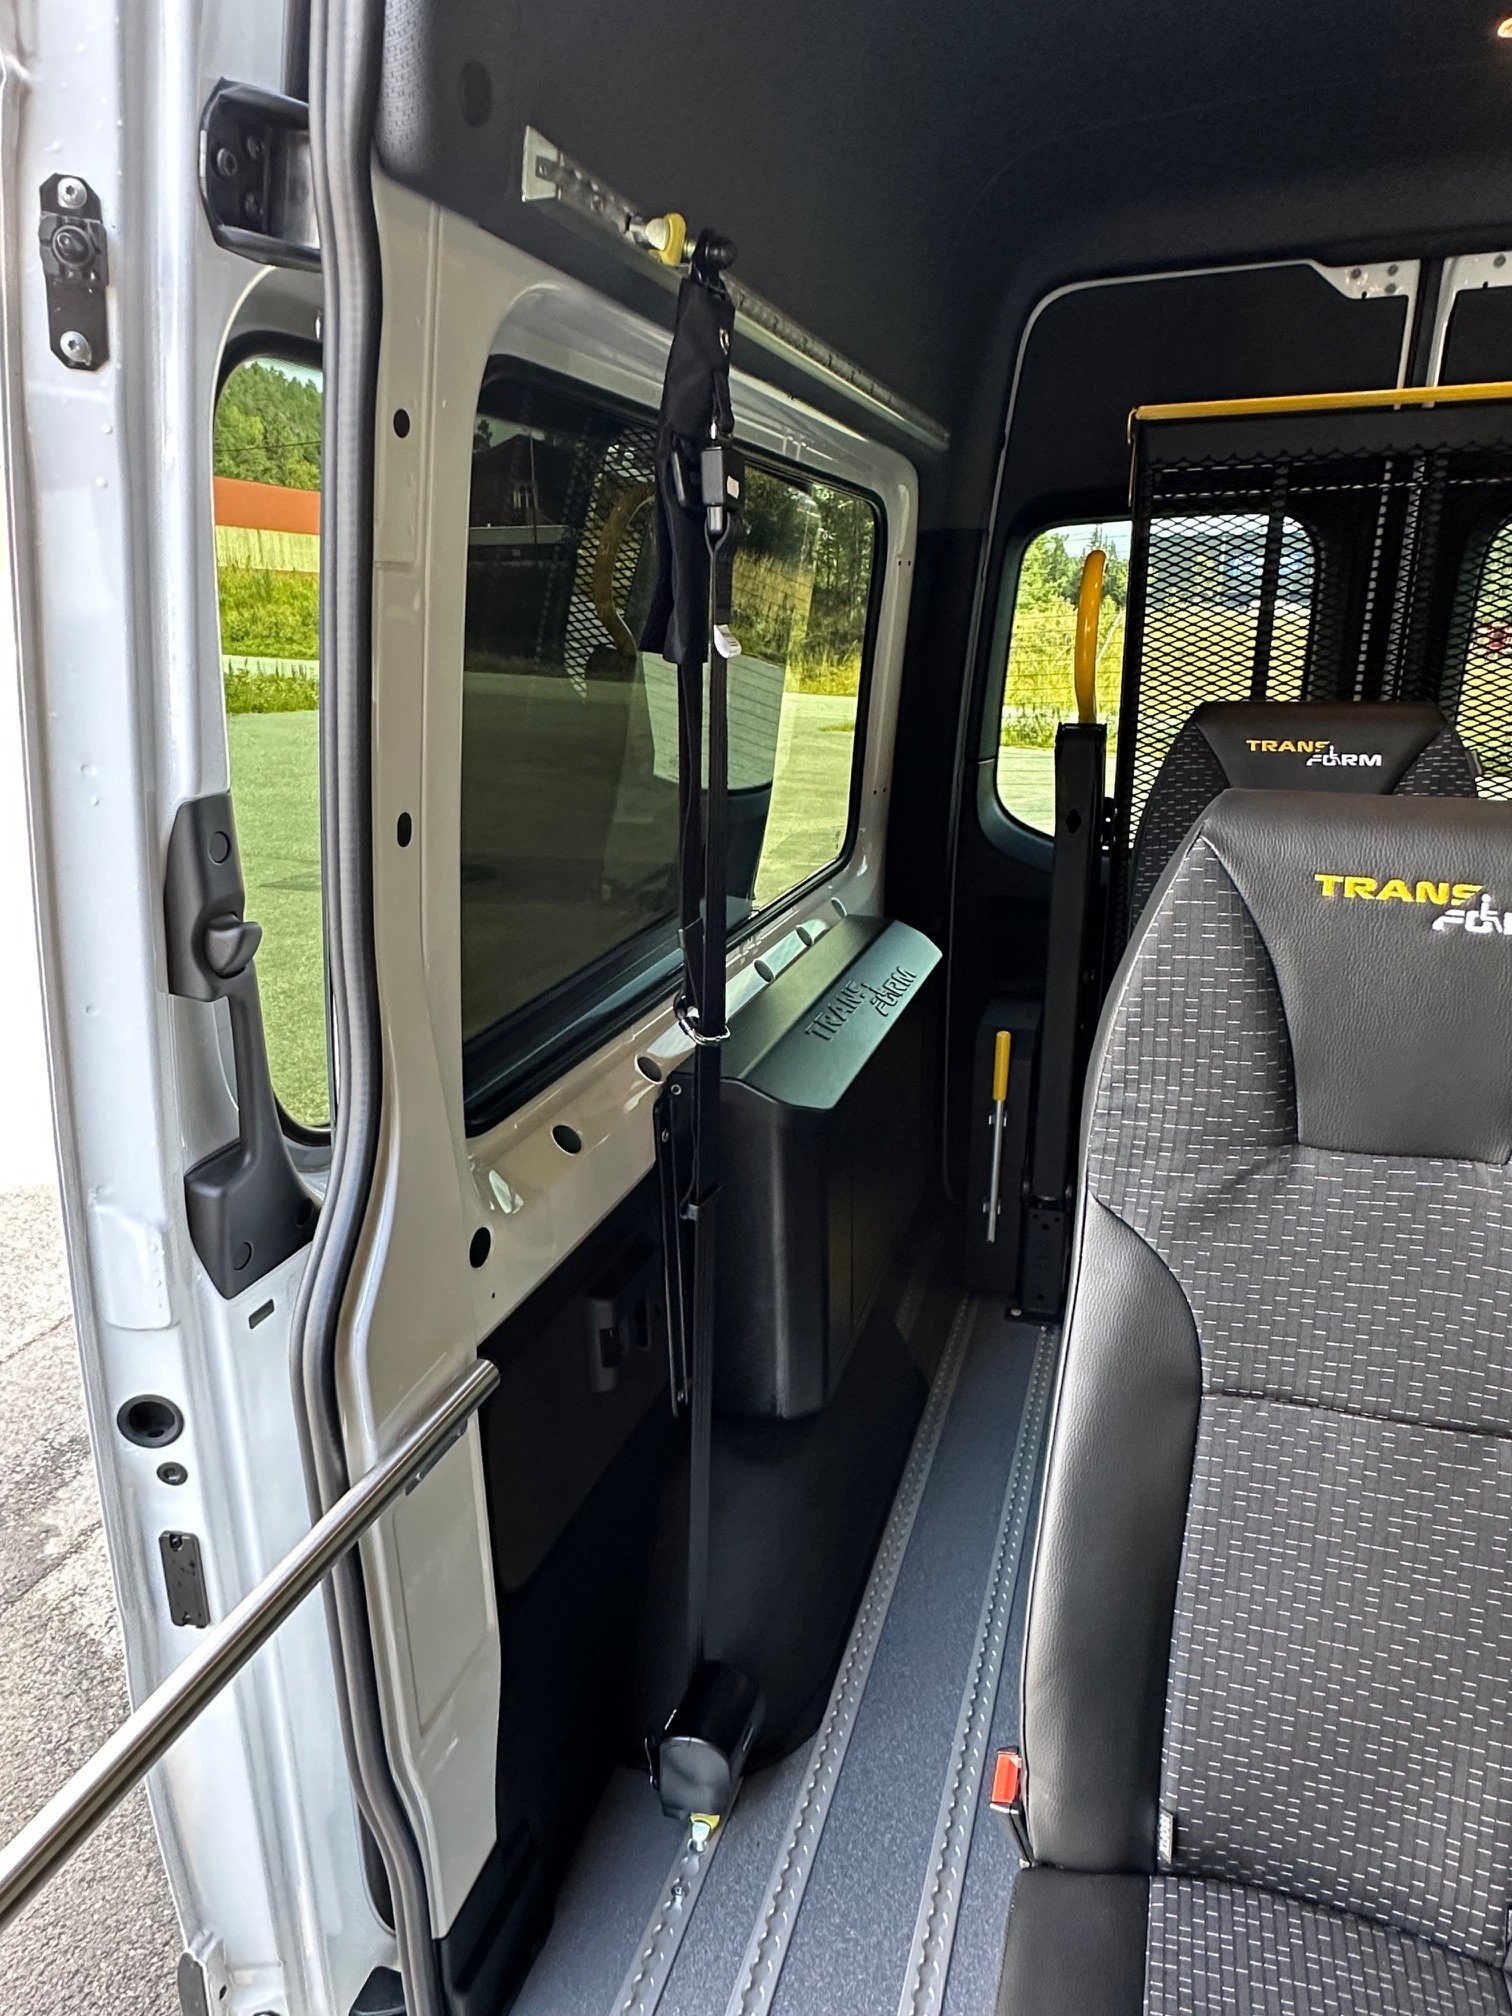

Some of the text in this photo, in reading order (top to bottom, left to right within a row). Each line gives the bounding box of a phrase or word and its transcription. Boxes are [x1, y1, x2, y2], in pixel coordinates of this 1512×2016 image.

[1246, 739, 1330, 753] TRANS
[1306, 751, 1382, 767] FORM
[1314, 873, 1484, 906] TRANS
